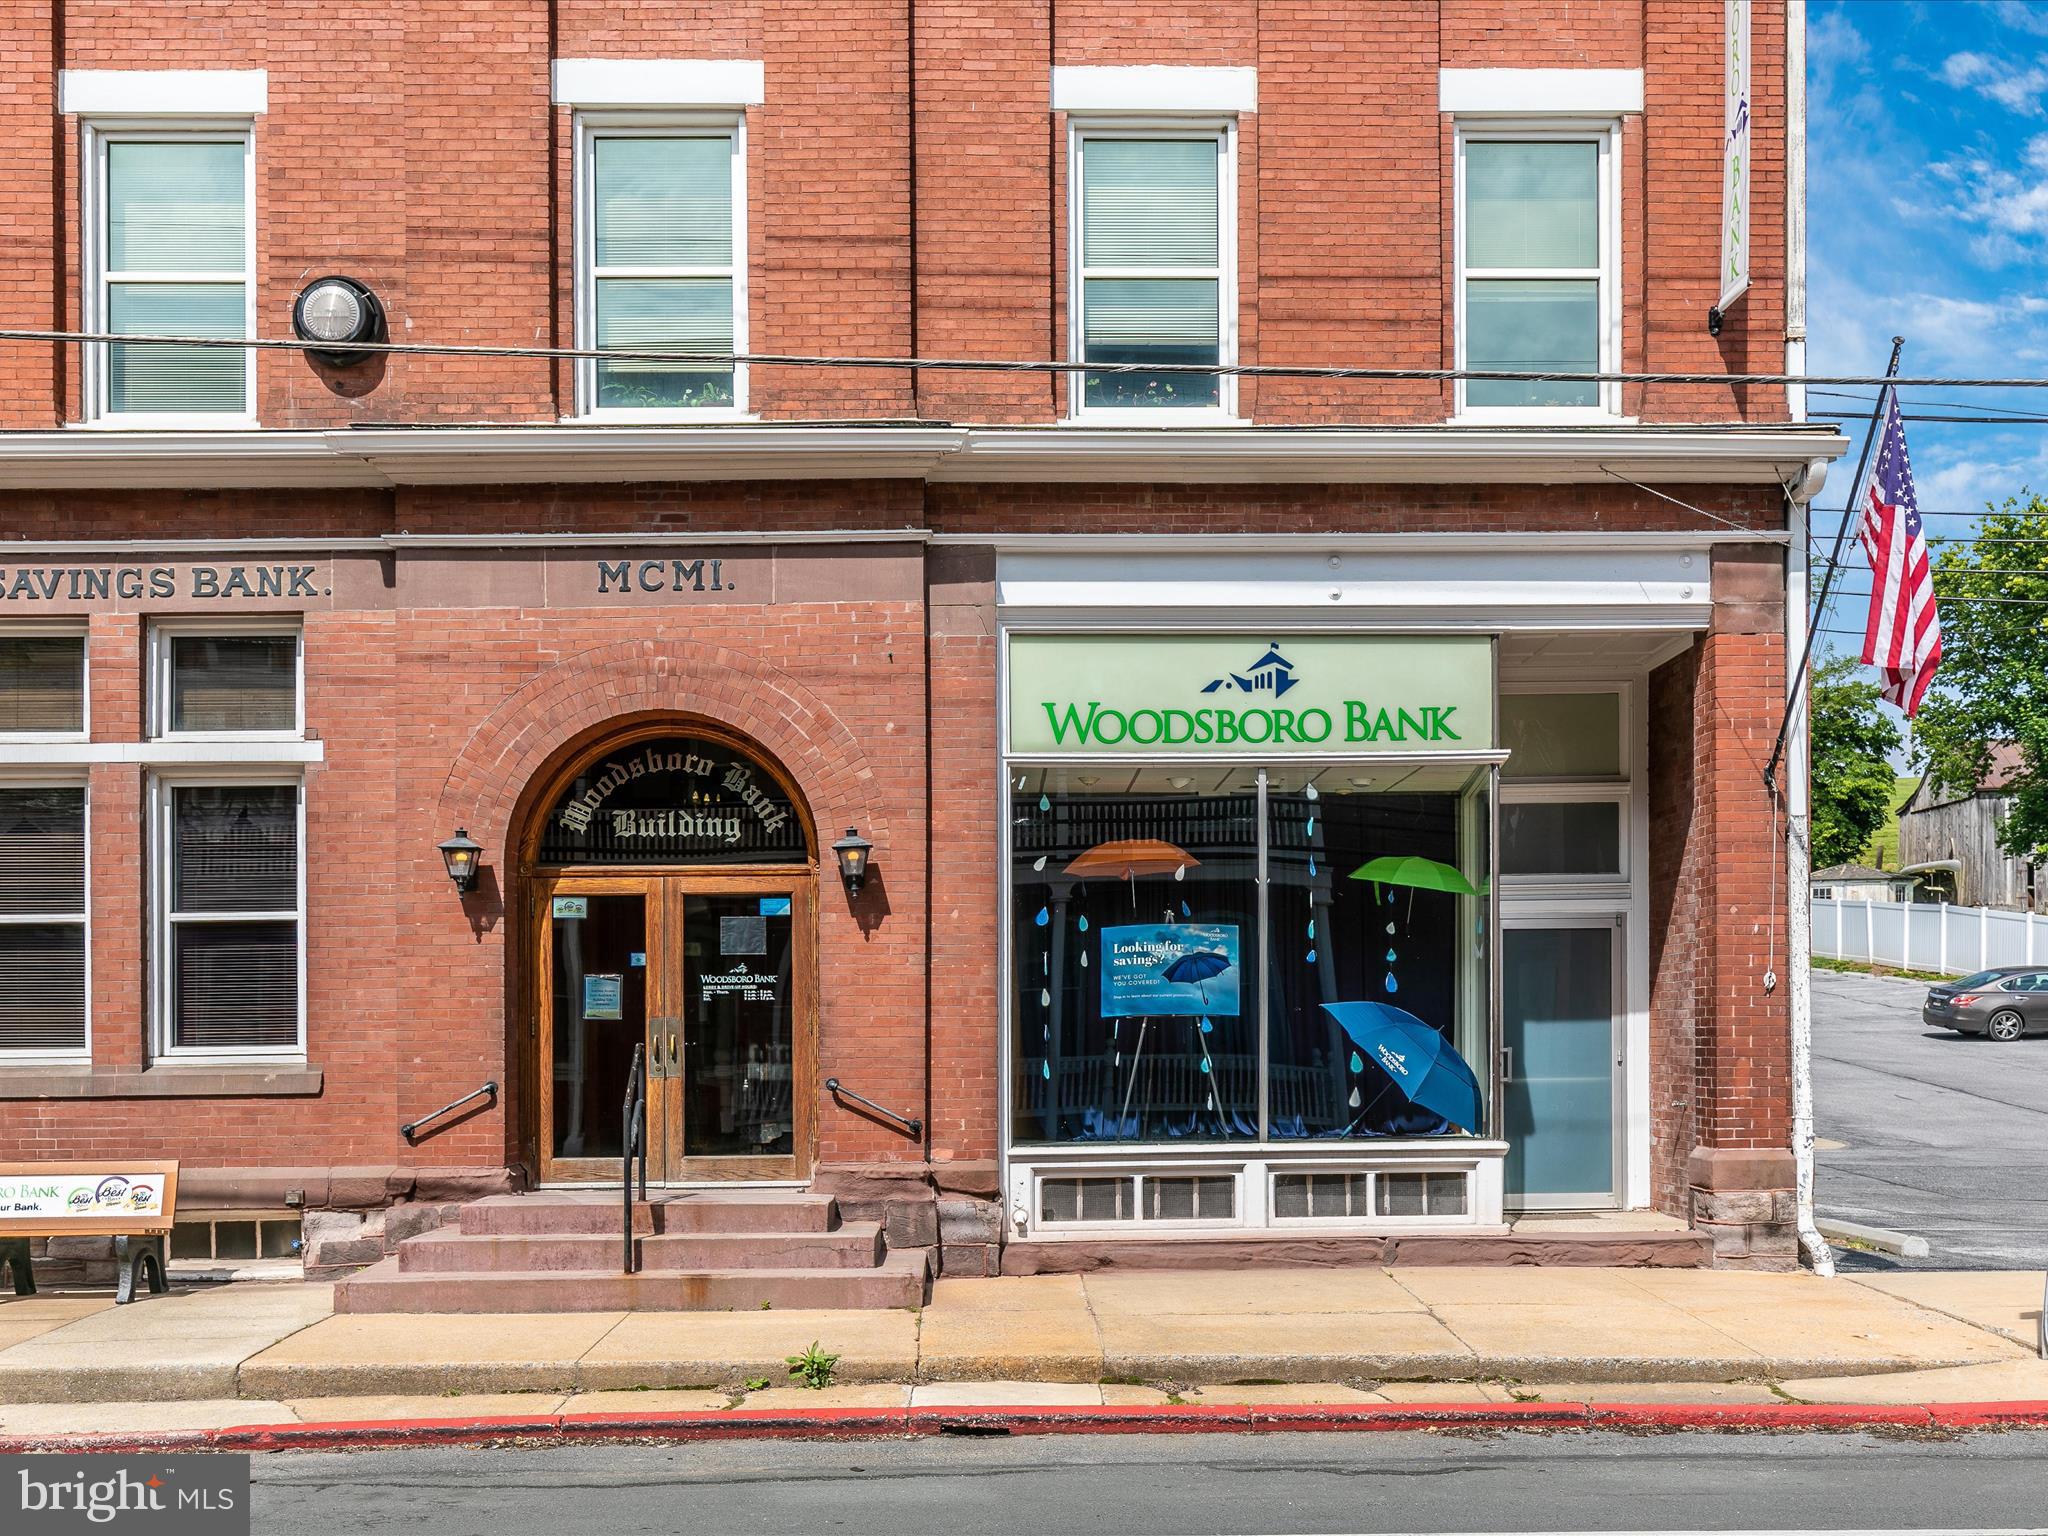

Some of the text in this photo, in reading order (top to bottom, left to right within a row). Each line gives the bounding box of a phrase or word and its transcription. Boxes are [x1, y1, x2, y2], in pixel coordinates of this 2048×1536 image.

[1731, 155, 1741, 282] BANK
[0, 566, 332, 599] AVINGS BANK.
[598, 560, 735, 592] MCMI.
[1041, 700, 1462, 745] WOODSBORO BANK
[559, 748, 789, 835] Woodsboro Bank
[612, 809, 742, 843] Building
[1113, 940, 1184, 954] Looking for
[1113, 954, 1165, 968] savings?
[700, 973, 777, 984] WOODSBORO BANK
[20, 1184, 59, 1198] BANK
[99, 1186, 127, 1197] Best
[131, 1193, 151, 1202] Best
[14, 1202, 42, 1211] Bank.
[71, 1195, 93, 1204] Best
